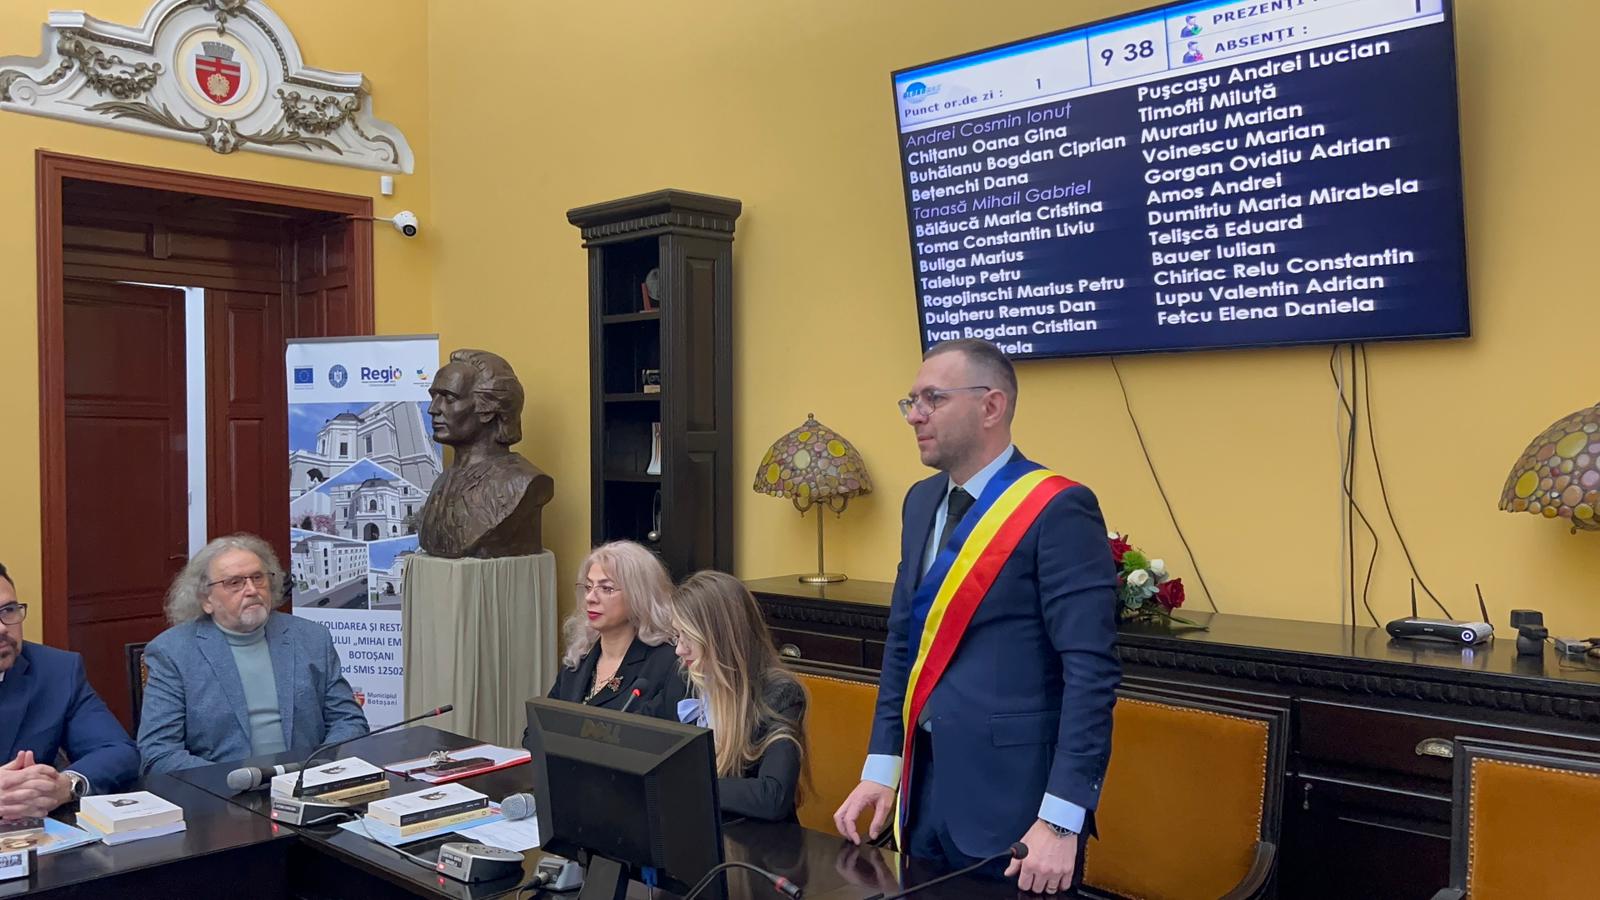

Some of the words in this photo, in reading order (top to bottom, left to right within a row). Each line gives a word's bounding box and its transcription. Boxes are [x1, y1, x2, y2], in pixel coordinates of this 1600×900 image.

[1123, 40, 1154, 62] 38
[1227, 55, 1302, 84] Andrei
[1309, 39, 1391, 68] Lucian
[904, 103, 939, 118] Punct
[944, 95, 978, 109] or.de
[982, 90, 994, 101] zi
[1138, 97, 1204, 123] Timofti
[906, 127, 955, 148] Andrei
[960, 115, 1021, 138] Cosmin
[1140, 118, 1218, 144] Murariu
[1224, 102, 1303, 129] Marian
[972, 133, 1019, 154] Oana
[1024, 125, 1067, 144] Gina
[1142, 135, 1238, 164] Voinescu
[1244, 121, 1325, 148] Marian
[910, 159, 982, 184] Buhăianu
[986, 146, 1054, 172] Bogdan
[1058, 133, 1126, 158] Ciprian
[1144, 162, 1223, 185] Gorgan
[1229, 146, 1302, 172] Ovidiu
[1309, 135, 1391, 161] Adrian
[983, 171, 1029, 191] Dana
[1146, 184, 1204, 205] Amos
[1210, 172, 1282, 197] Andrei
[913, 197, 967, 220] Tanasă
[972, 191, 1021, 212] Mihail
[1025, 180, 1092, 203] Gabriel
[1148, 202, 1231, 226] Dumitriu
[1238, 194, 1302, 215] Maria
[1309, 178, 1419, 206] Mirabela
[915, 217, 979, 238] Bălăucă
[984, 210, 1031, 228] Maria
[1036, 200, 1103, 220] Cristina
[1225, 214, 1303, 238] Eduard
[917, 239, 959, 255] Toma
[963, 226, 1051, 249] Constantin
[1057, 219, 1095, 237] Liviu
[919, 251, 966, 273] Buliga
[970, 249, 1024, 267] Marius
[1151, 248, 1211, 266] Bauer
[1217, 240, 1276, 259] Iulian
[1153, 266, 1227, 286] Chiriac
[1233, 260, 1279, 279] Relu
[1286, 248, 1414, 274] Constantin
[980, 267, 1021, 285] Petru
[1155, 289, 1203, 307] Lupu
[1209, 280, 1299, 302] Valentin
[1306, 274, 1385, 294] Adrian
[923, 286, 1013, 308] Rogojinschi
[1017, 281, 1073, 300] Marius
[1078, 276, 1124, 294] Petru
[925, 305, 994, 326] Dulgheru
[999, 300, 1055, 319] Remus
[1060, 298, 1096, 314] Dan
[1157, 309, 1213, 326] Fetcu
[1219, 303, 1278, 322] Elena
[1285, 296, 1375, 317] Daniela
[926, 326, 960, 342] Ivan
[964, 319, 1027, 341] Bogdan
[1032, 317, 1098, 335] Cristian
[361, 365, 402, 384] Regio
[331, 636, 351, 645] ULUI
[388, 637, 402, 647] EM
[340, 664, 351, 673] od
[353, 665, 375, 675] SMIS
[378, 666, 403, 676] 12502
[367, 691, 397, 700] Municipiul
